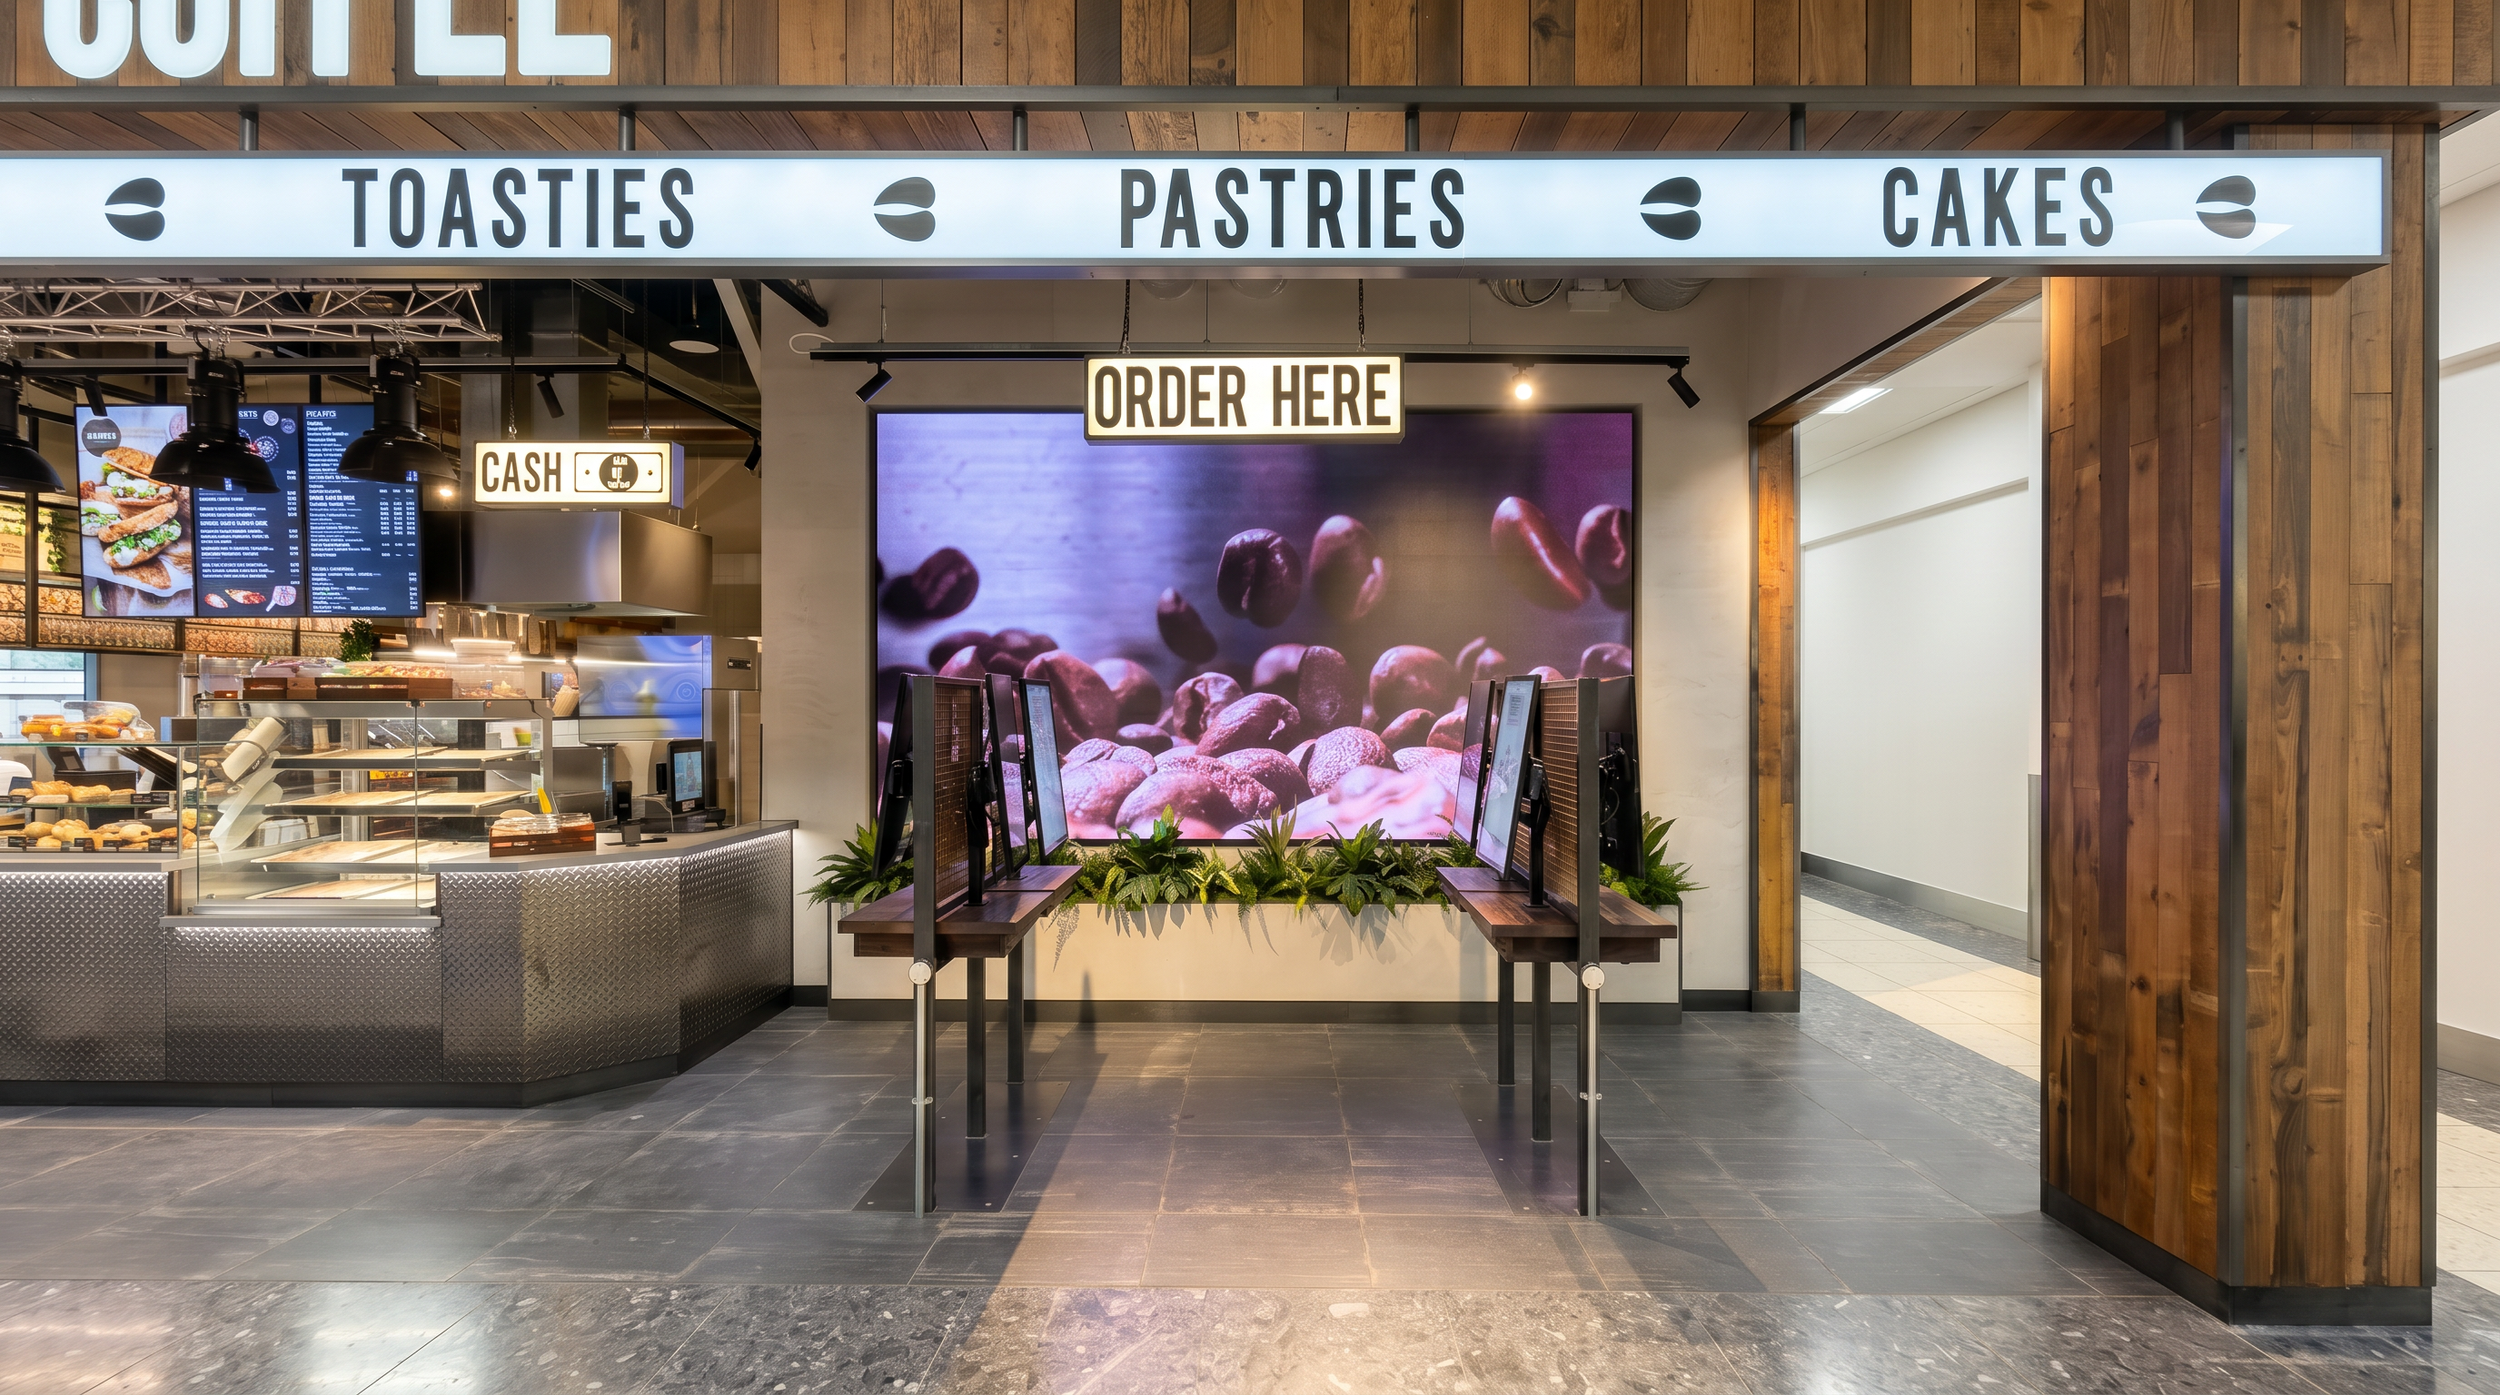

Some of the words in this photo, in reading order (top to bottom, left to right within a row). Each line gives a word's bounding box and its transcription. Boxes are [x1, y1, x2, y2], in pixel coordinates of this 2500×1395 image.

[342, 167, 694, 249] TOASTIES
[1120, 167, 1465, 249] PASTRIES
[1883, 166, 2114, 248] CAKES
[1095, 365, 1247, 429] ORDER
[1273, 364, 1391, 427] HERE
[481, 451, 562, 493] CASH
